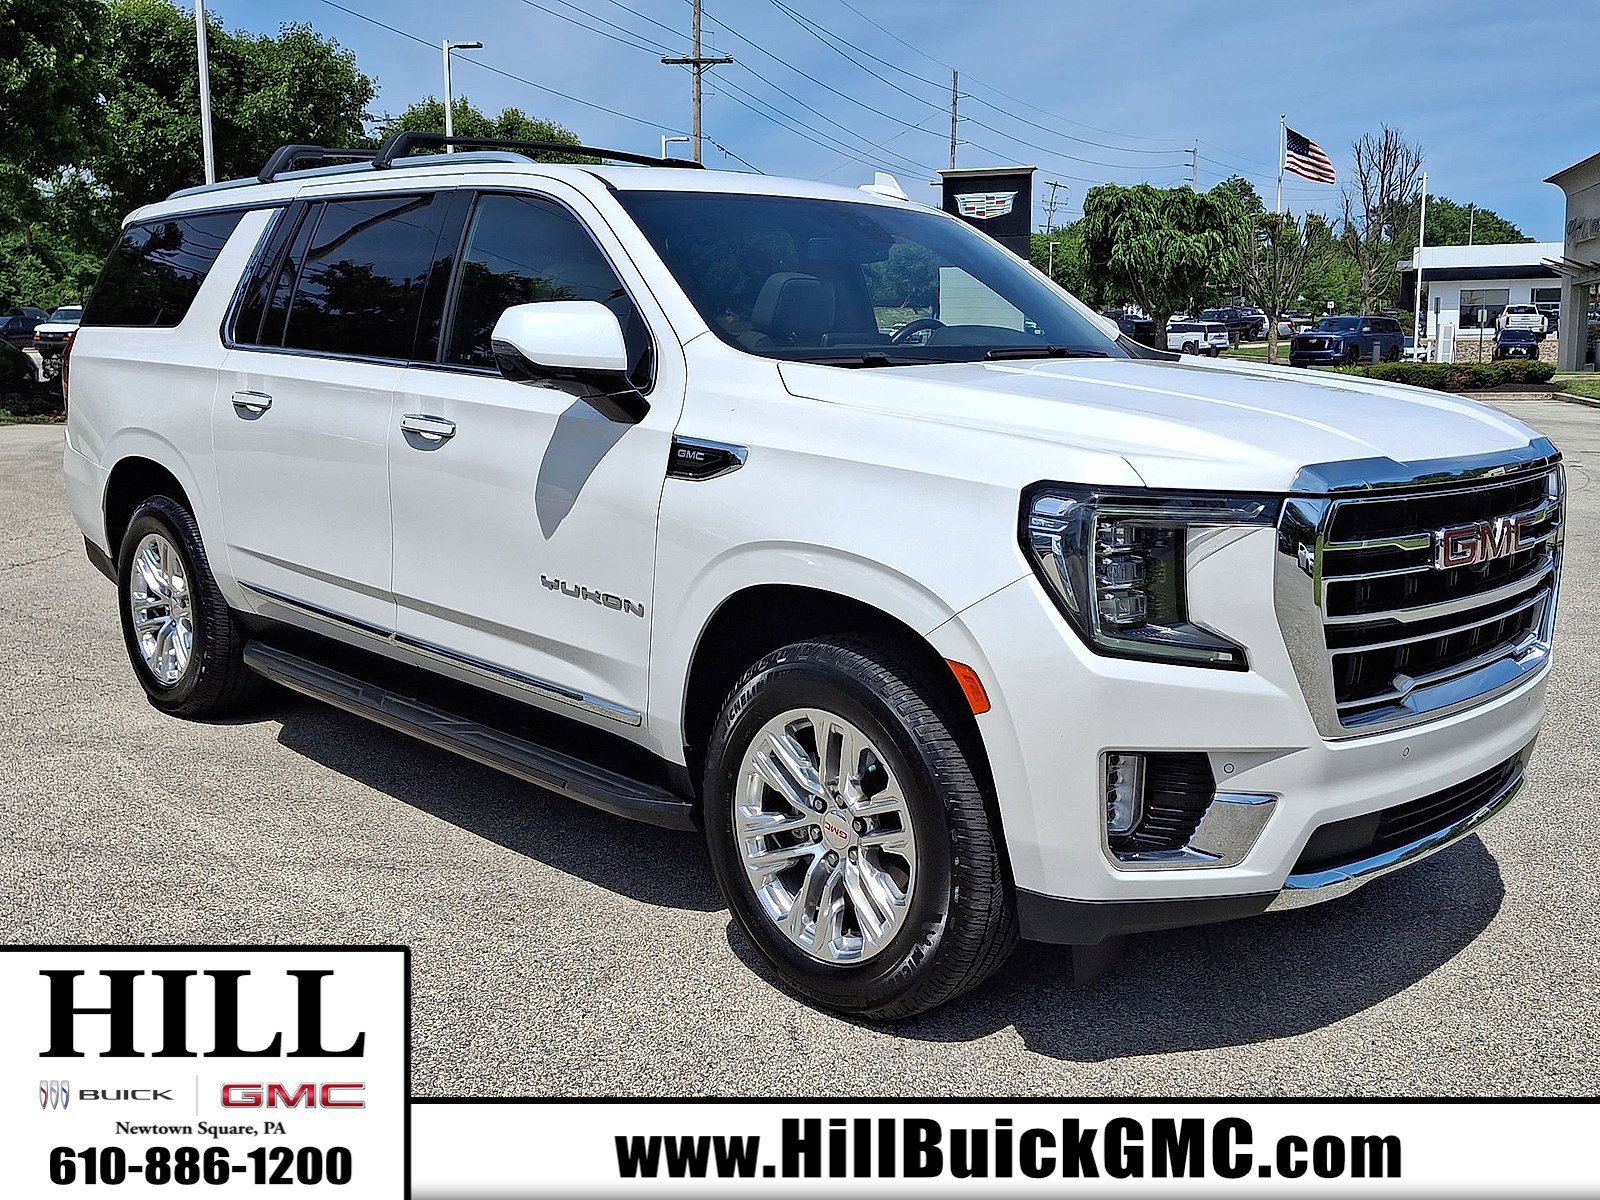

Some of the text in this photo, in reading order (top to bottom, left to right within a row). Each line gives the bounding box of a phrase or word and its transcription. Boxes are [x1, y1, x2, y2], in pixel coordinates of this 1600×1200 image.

[677, 449, 705, 461] GMC
[1434, 515, 1536, 571] GMC
[540, 574, 644, 618] YUKON
[825, 821, 848, 840] GMC
